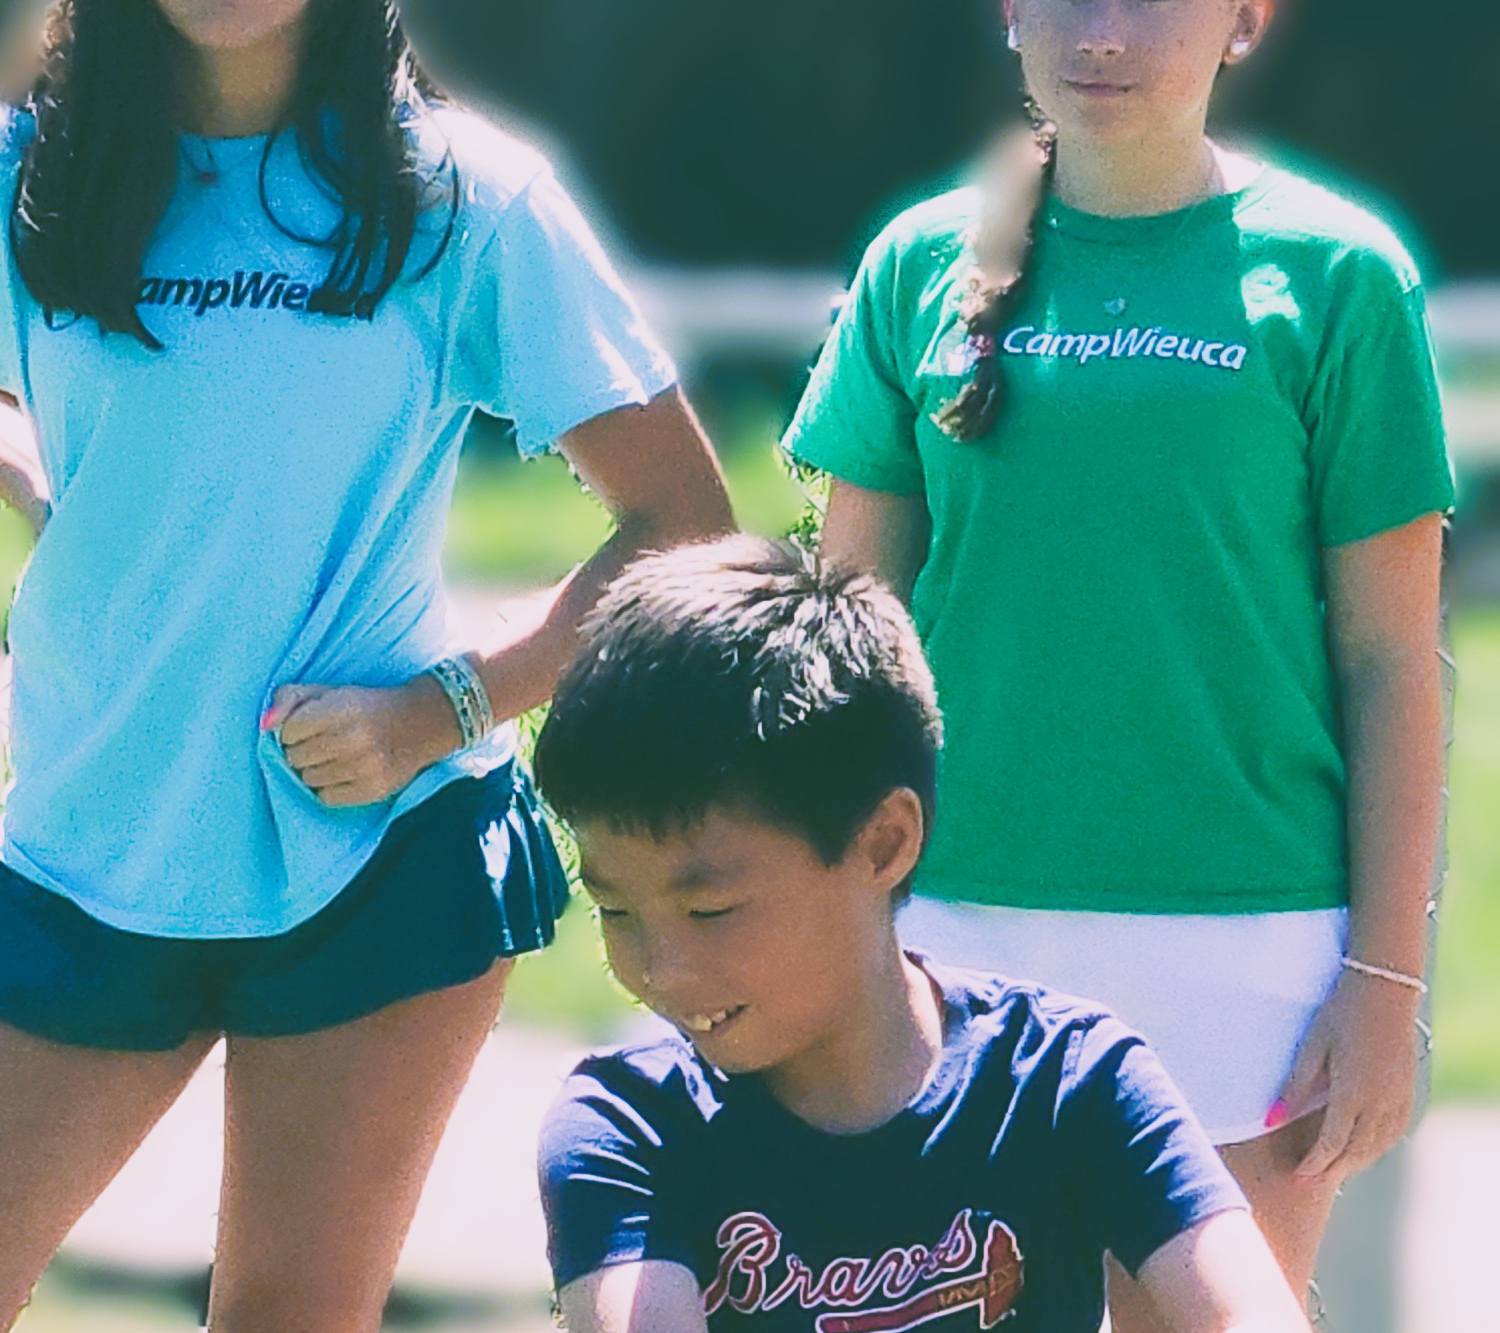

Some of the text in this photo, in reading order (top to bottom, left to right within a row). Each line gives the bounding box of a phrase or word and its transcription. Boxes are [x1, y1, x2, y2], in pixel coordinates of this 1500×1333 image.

[138, 271, 310, 316] ampWie
[1003, 326, 1247, 369] CampWieuca
[702, 1208, 976, 1313] Braves
